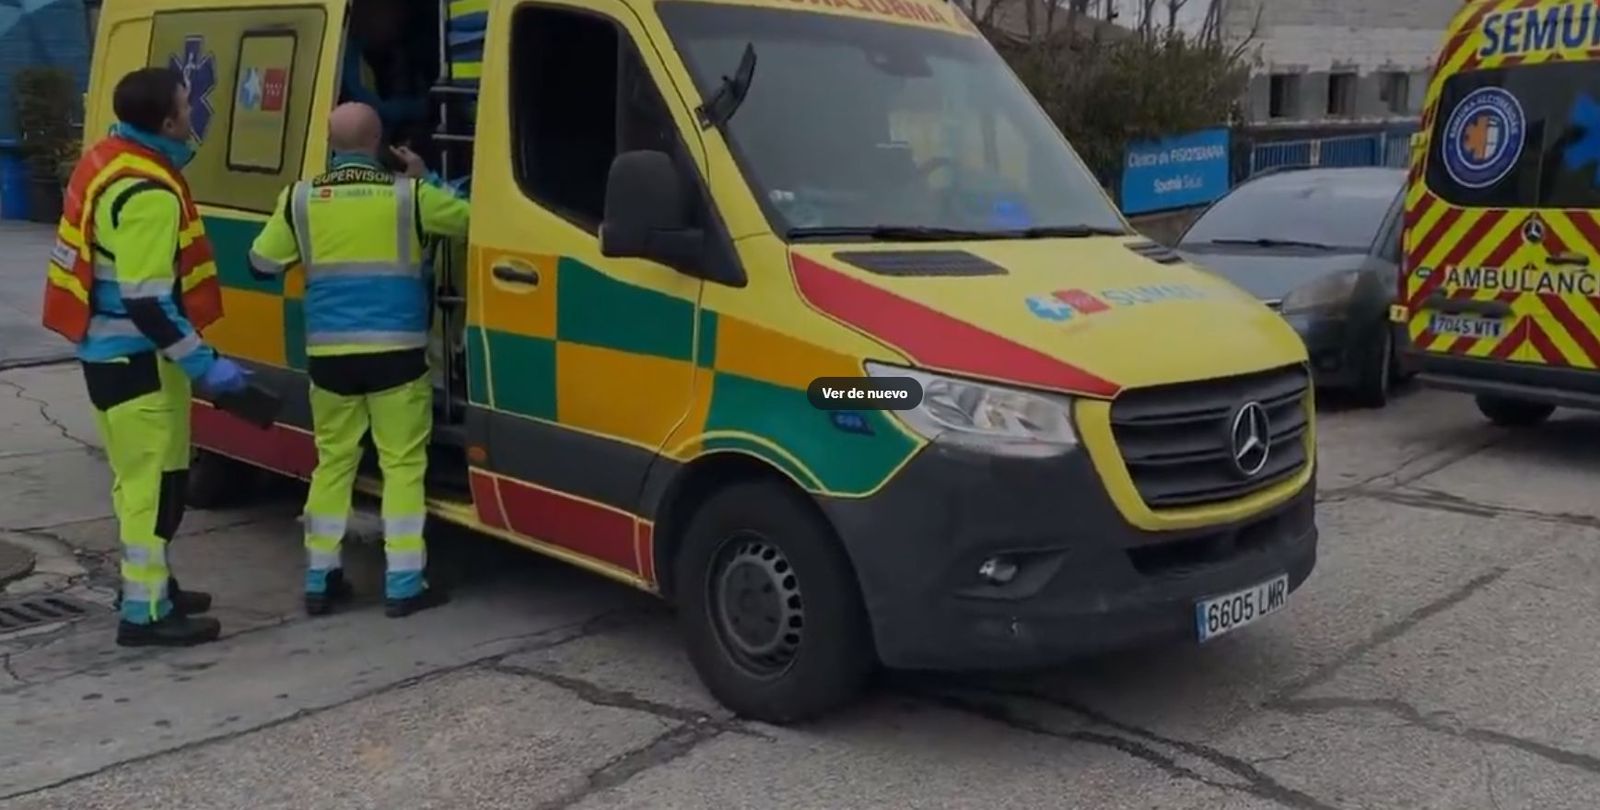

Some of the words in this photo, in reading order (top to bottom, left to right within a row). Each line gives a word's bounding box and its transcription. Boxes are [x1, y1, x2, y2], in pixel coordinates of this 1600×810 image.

[313, 168, 394, 184] SUPERVISOR
[1446, 267, 1597, 296] AMBULANC
[1208, 592, 1254, 633] 6605
[1258, 580, 1285, 616] LMR
